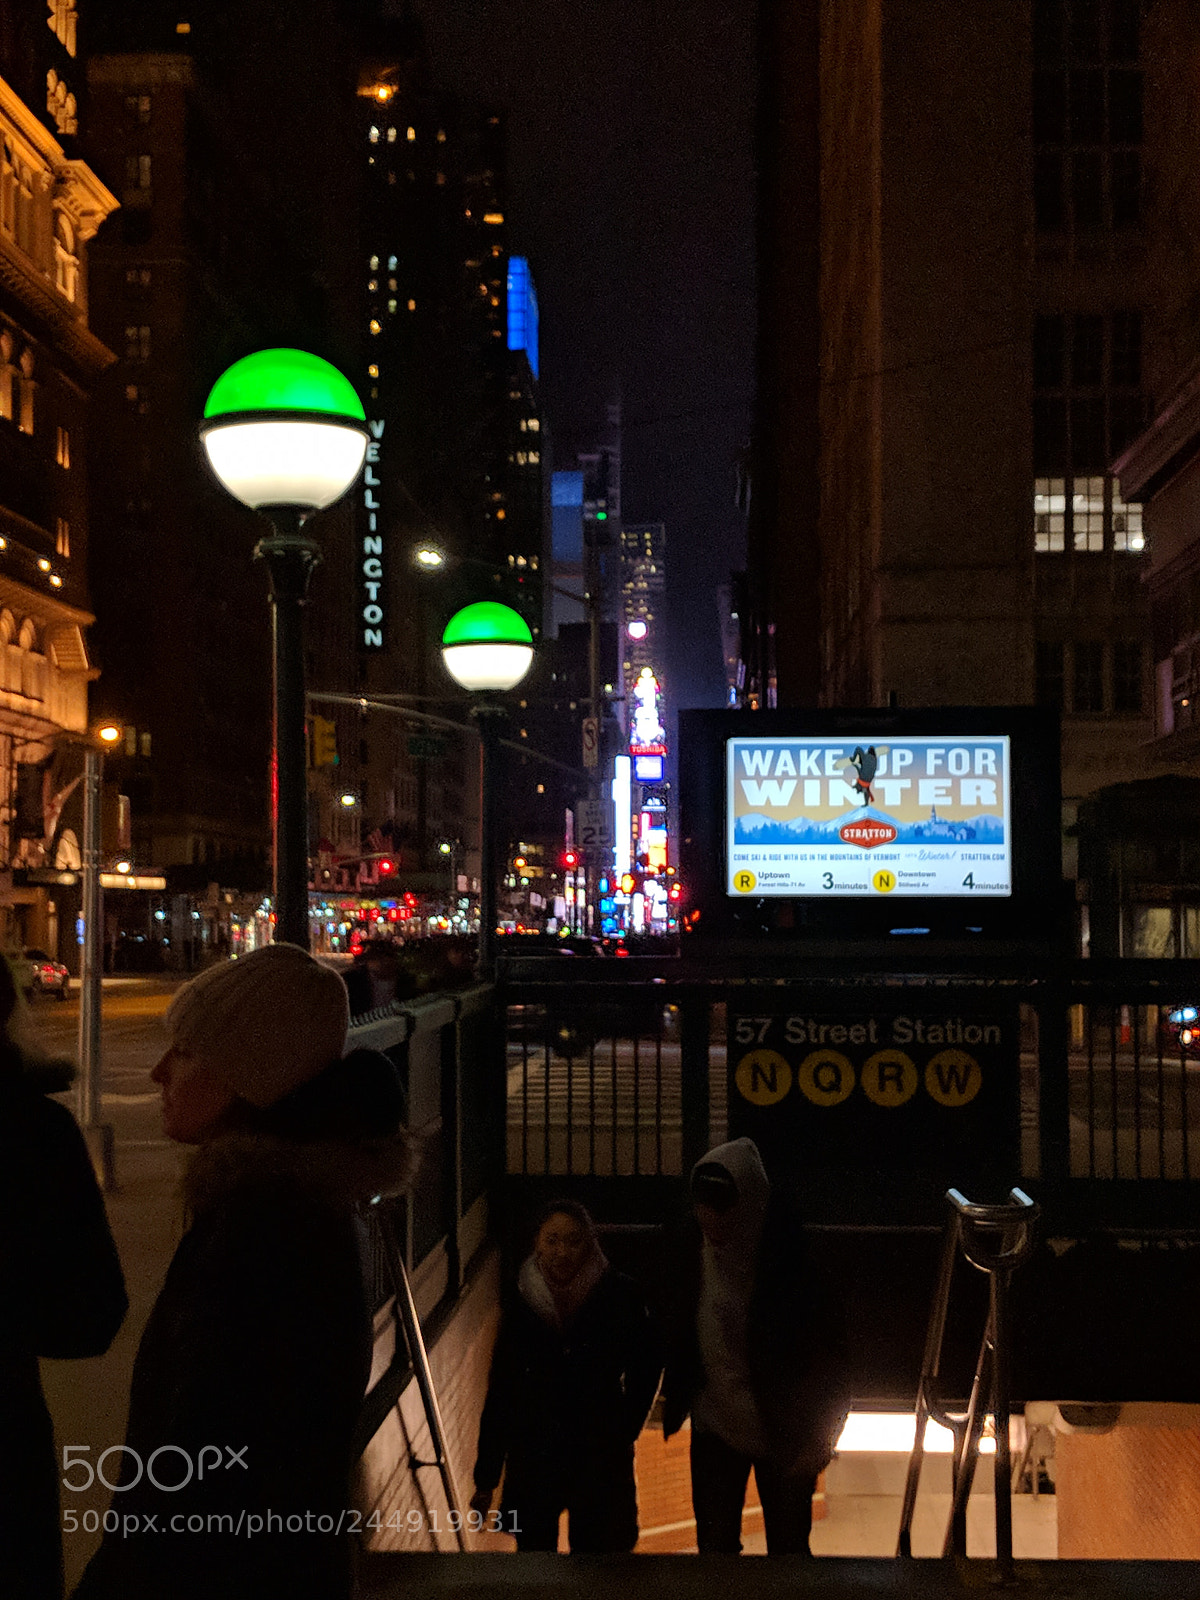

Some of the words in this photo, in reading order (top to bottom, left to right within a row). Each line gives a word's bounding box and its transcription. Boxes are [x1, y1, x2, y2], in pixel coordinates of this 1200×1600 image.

[741, 748, 844, 777] WAKE
[927, 748, 998, 777] FOR
[741, 778, 998, 807] WINTER
[844, 828, 893, 841] STRATTON
[733, 853, 749, 861] COME
[751, 853, 761, 861] SKI
[769, 853, 781, 861] RIDE
[784, 853, 798, 861] WITH
[800, 853, 807, 861] US
[809, 853, 816, 861] IN
[817, 853, 827, 861] THE
[830, 853, 863, 861] MOUNTAINS
[864, 853, 871, 861] OF
[873, 853, 900, 861] VERMONT
[961, 853, 1006, 861] STRATTON.COM
[740, 875, 750, 887] R
[758, 871, 790, 880] Uptown
[822, 872, 834, 889] 3
[834, 882, 868, 890] minutes
[879, 875, 890, 887] N
[962, 872, 975, 890] 4
[975, 882, 1009, 890] minutes
[735, 1017, 773, 1044] 57
[784, 1016, 879, 1045] Street
[892, 1015, 1001, 1045] Station
[751, 1062, 778, 1093] N
[813, 1062, 842, 1094] Q
[878, 1062, 905, 1093] R
[935, 1063, 972, 1095] W
